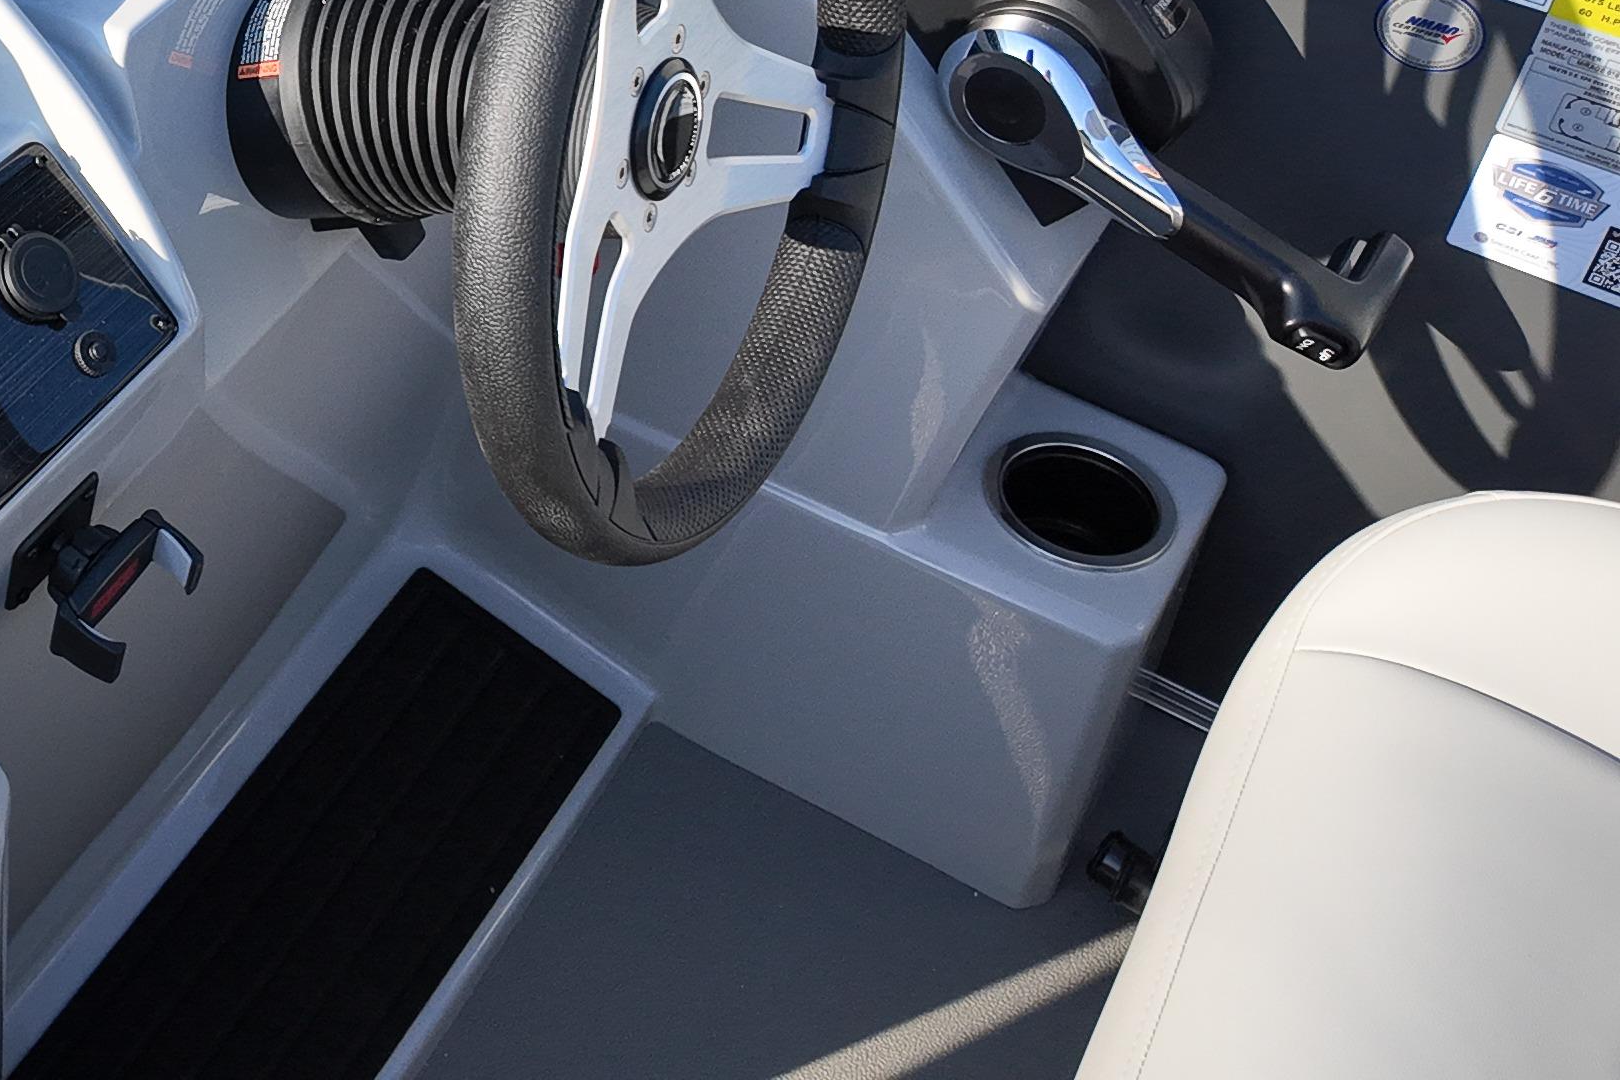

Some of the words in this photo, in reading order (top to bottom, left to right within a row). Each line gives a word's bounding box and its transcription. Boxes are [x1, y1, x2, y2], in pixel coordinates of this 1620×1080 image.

[1578, 8, 1593, 18] 60
[1497, 172, 1537, 196] LIFE
[1533, 188, 1558, 205] 6
[1558, 192, 1598, 217] TIME
